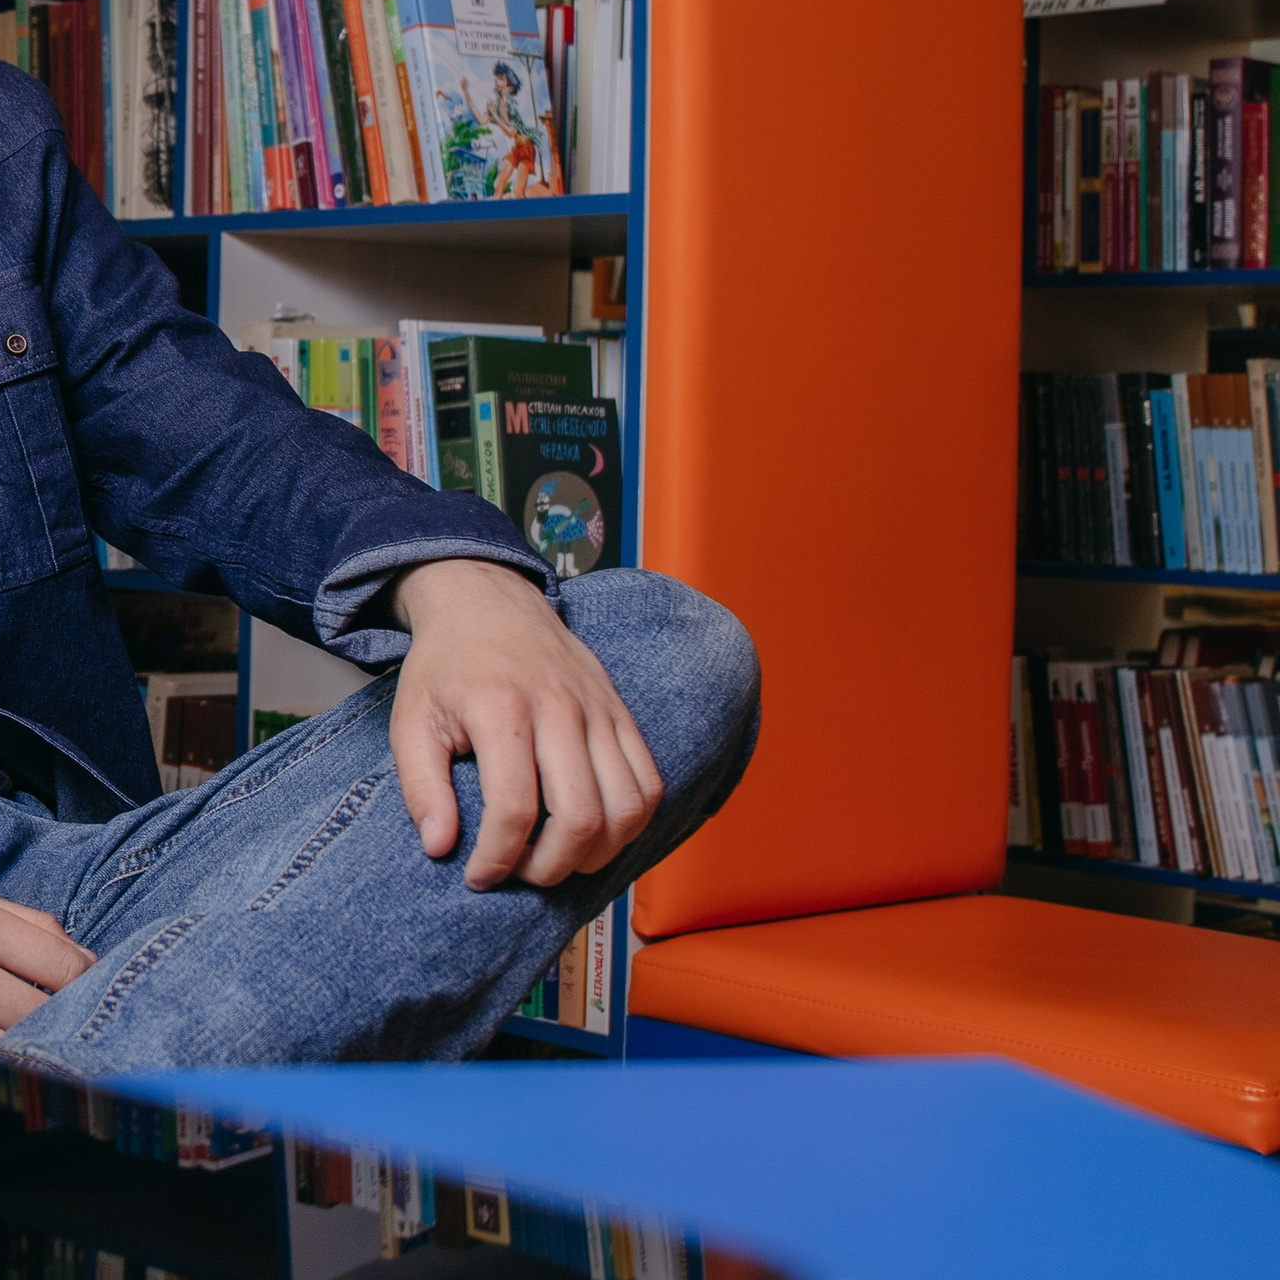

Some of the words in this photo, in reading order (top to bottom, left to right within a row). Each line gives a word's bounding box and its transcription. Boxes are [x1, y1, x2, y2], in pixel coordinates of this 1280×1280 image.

[481, 42, 508, 53] ВЕТЕР
[528, 402, 562, 415] СТЕПАН
[564, 404, 607, 418] ПИСАХОВ
[557, 416, 608, 438] НЕБЕСНОГО
[540, 442, 580, 462] ЧЕРДАКА
[483, 439, 496, 502] ПИСАХОВ
[594, 914, 606, 937] ТЕТ
